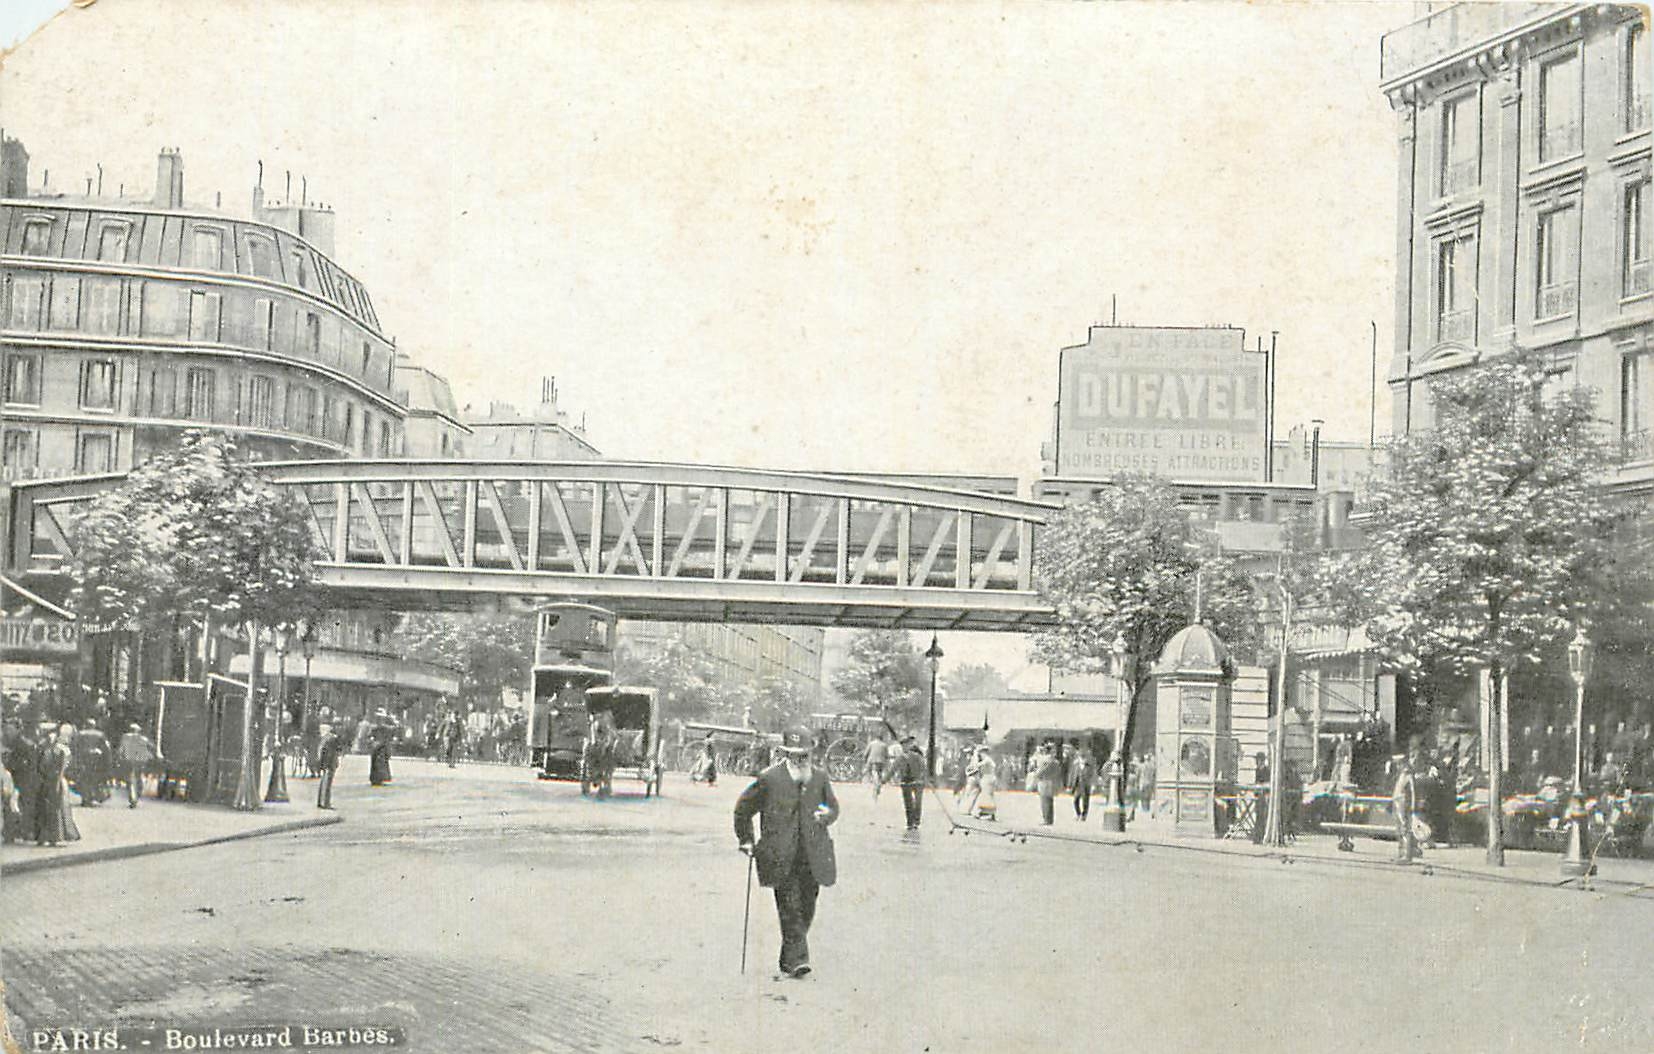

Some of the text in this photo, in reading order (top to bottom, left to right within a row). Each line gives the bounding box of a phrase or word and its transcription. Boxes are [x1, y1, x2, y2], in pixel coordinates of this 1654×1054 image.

[1173, 334, 1234, 350] FACE
[1077, 372, 1257, 420] DUFAYEL
[1168, 455, 1261, 472] ATTRACTIONS
